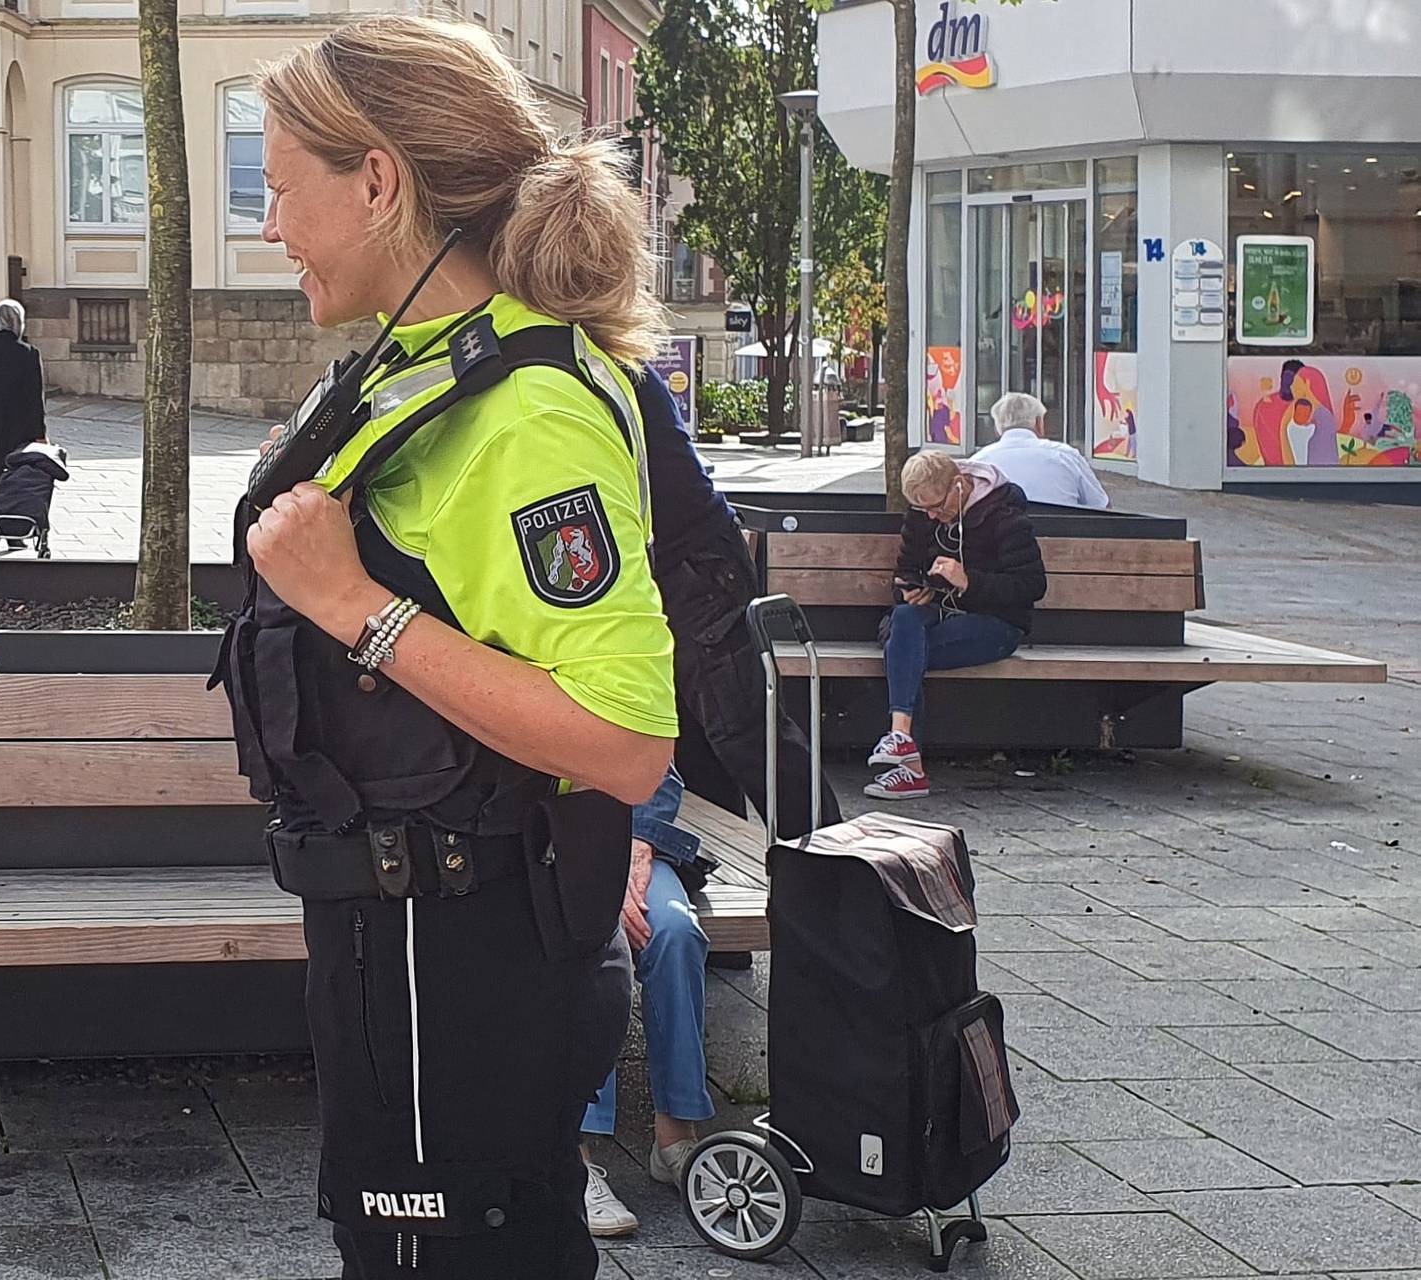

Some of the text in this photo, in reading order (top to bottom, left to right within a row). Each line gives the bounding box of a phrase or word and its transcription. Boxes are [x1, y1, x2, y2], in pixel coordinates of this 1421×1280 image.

[928, 2, 980, 62] dm
[1143, 238, 1165, 262] 14
[729, 315, 748, 327] sky
[521, 496, 592, 535] POLIZEI
[361, 1191, 446, 1218] POLIZEI
